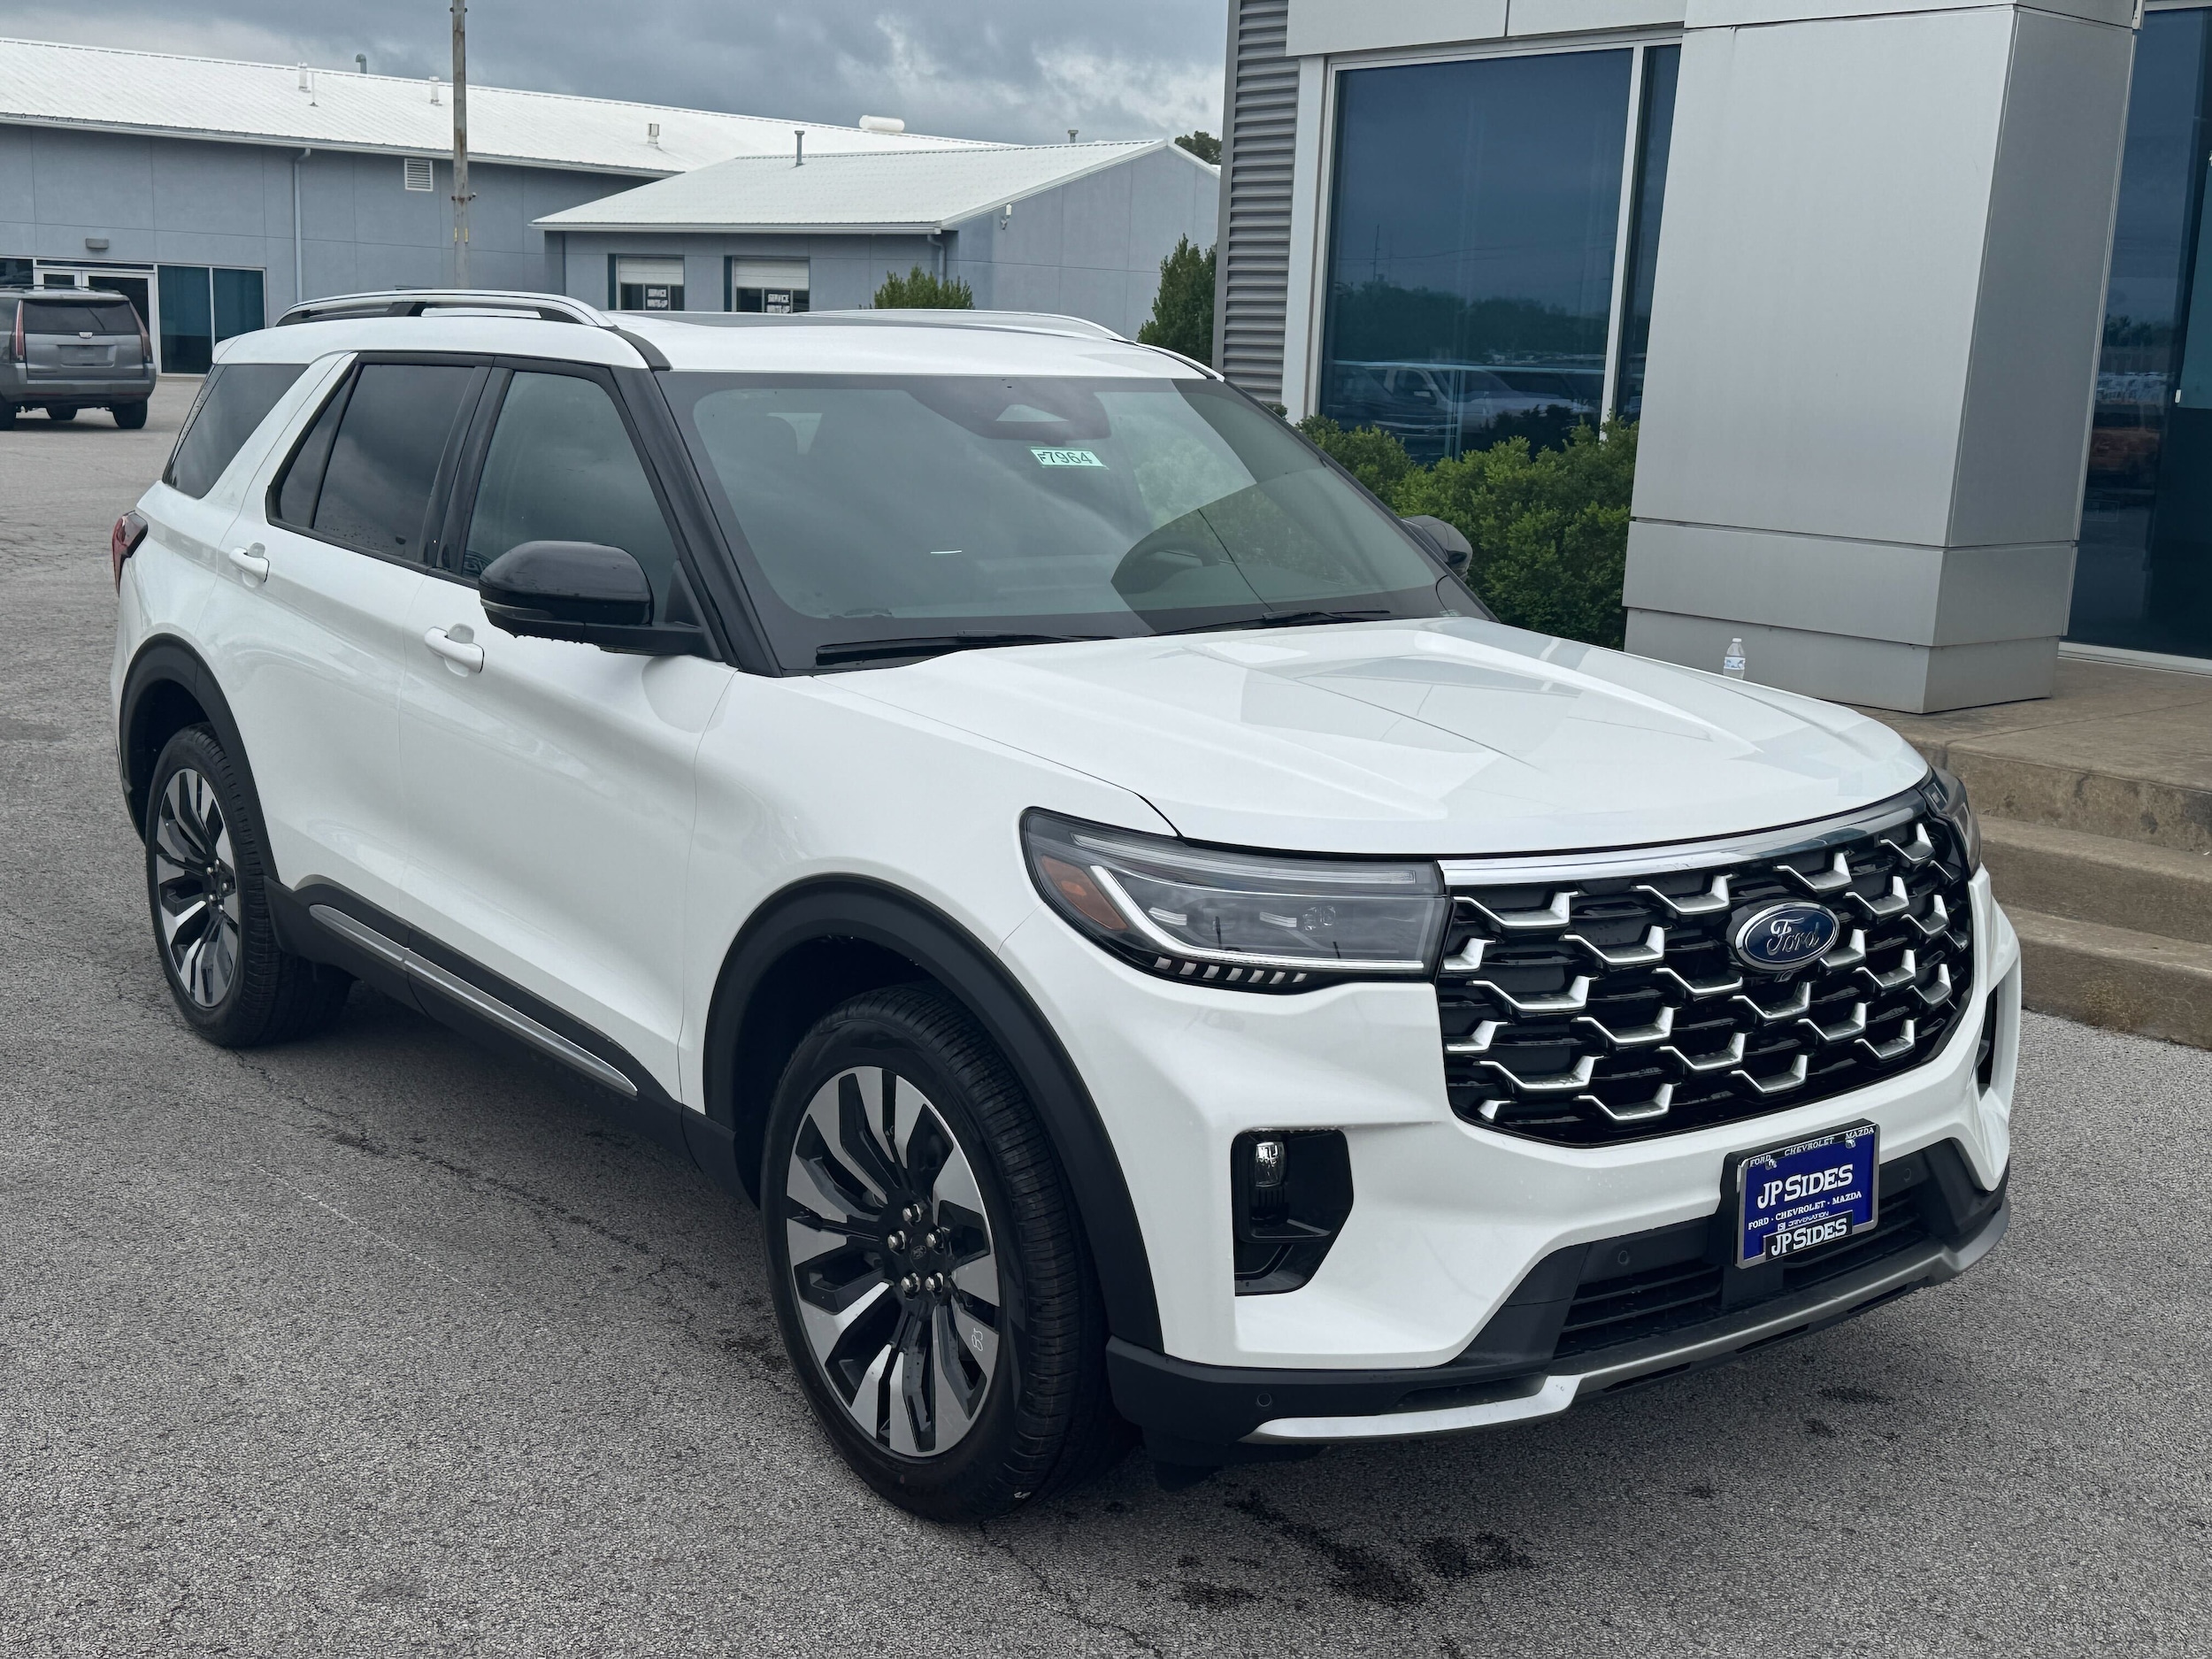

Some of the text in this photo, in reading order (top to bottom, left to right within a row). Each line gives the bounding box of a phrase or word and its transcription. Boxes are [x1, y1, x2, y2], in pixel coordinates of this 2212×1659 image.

[1766, 917, 1820, 956] Ford
[1749, 1126, 1875, 1168] FORD CHEVROLET MAZDA
[1747, 1217, 1770, 1231] FORD
[1775, 1200, 1826, 1221] CHEVROLET
[1832, 1191, 1863, 1205] MAZDA
